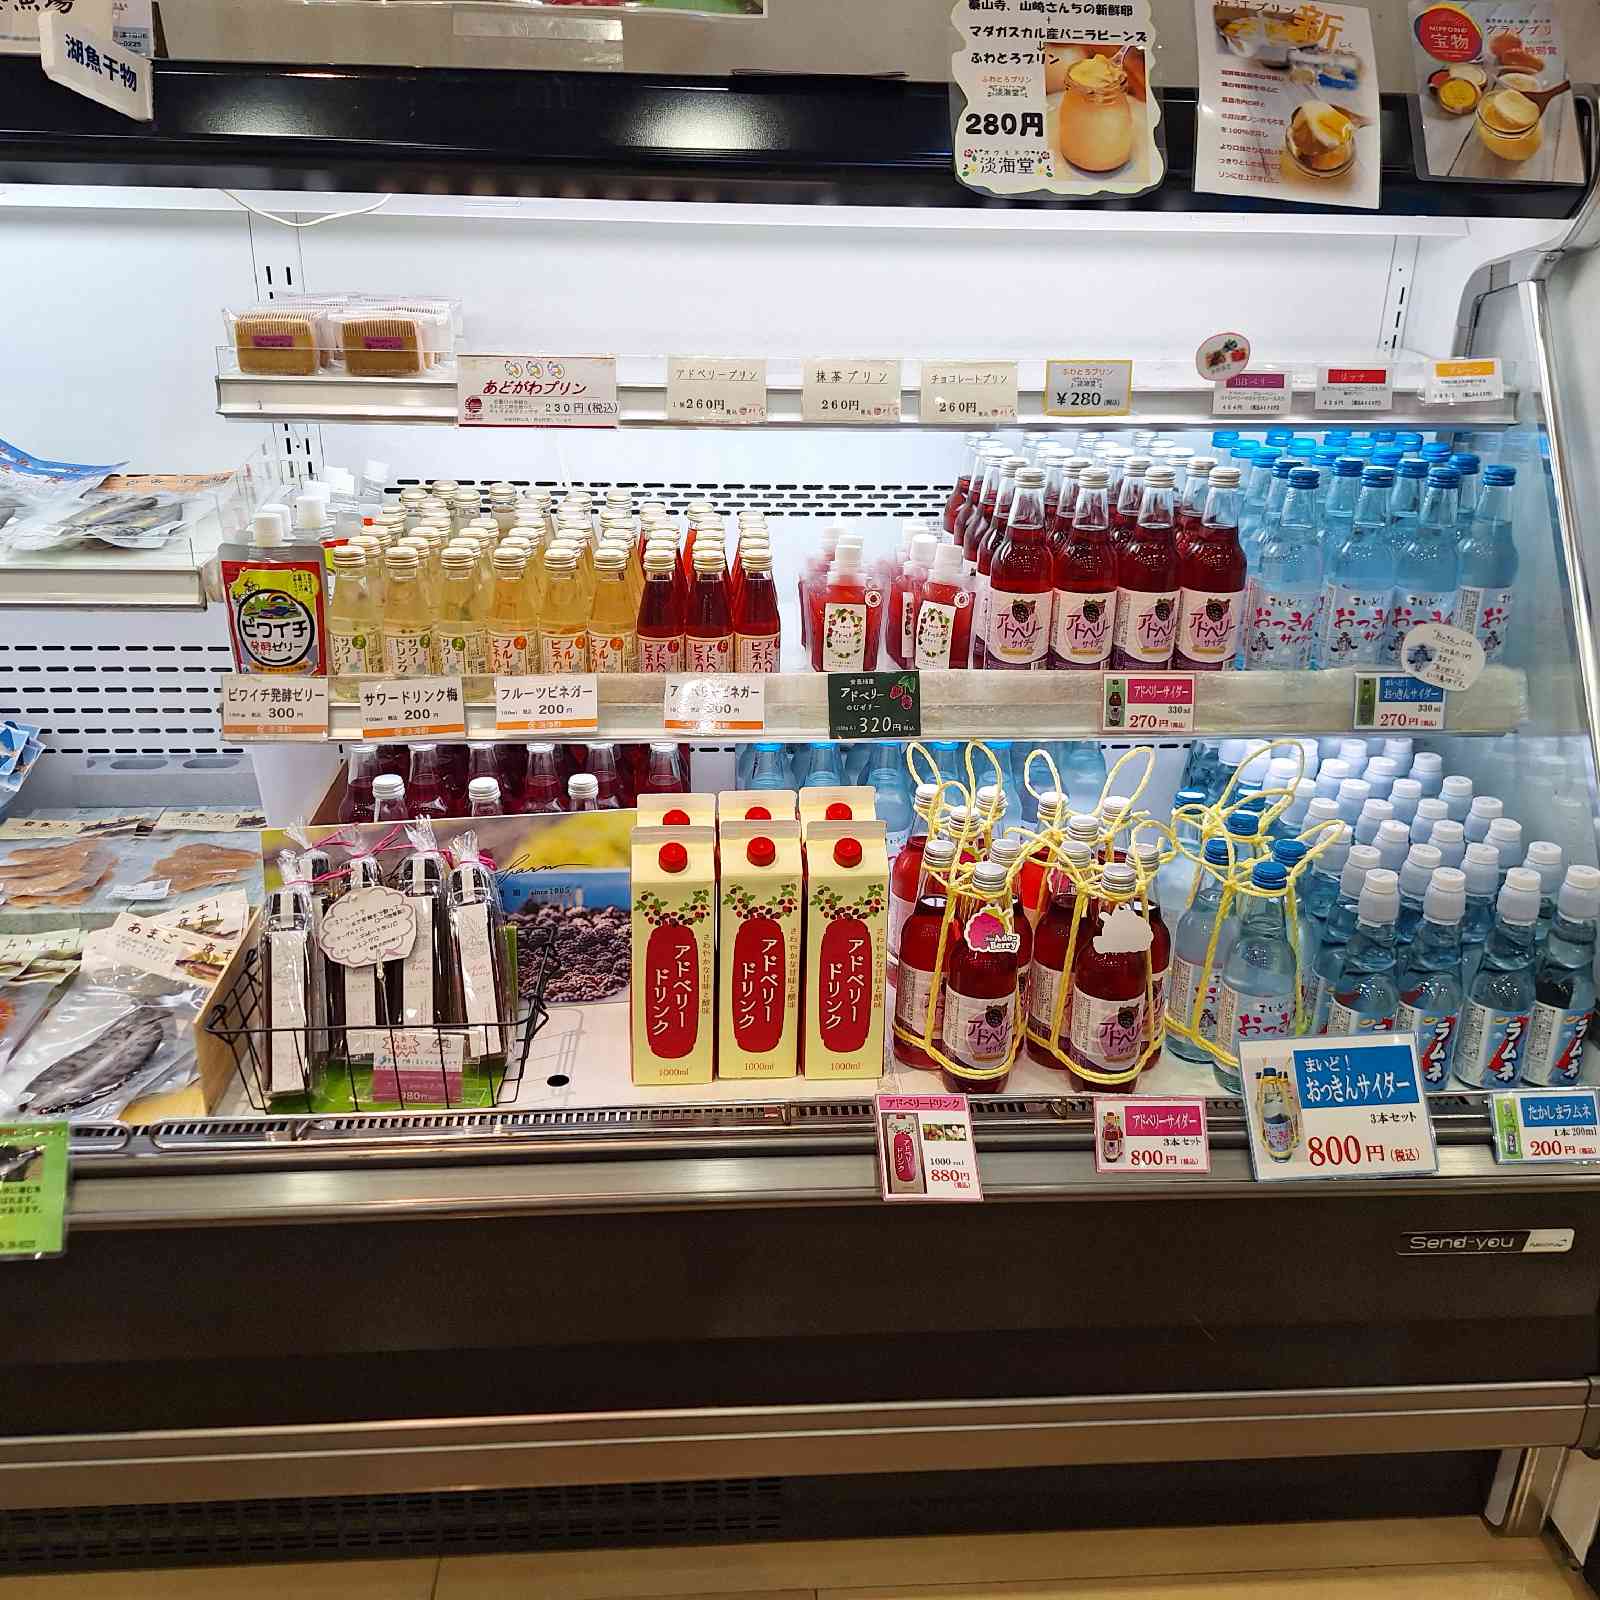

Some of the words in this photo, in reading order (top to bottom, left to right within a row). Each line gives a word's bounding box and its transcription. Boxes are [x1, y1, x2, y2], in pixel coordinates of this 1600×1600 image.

[1429, 33, 1470, 50] 宝物
[65, 33, 137, 92] 湖魚干物
[970, 53, 1060, 65] ふわとろプリン
[965, 112, 1044, 138] 280円
[980, 158, 1035, 175] 淡海堂
[482, 379, 588, 395] あどがわプリン
[931, 374, 1008, 384] チョコレートプリン
[241, 616, 308, 638] ビワイチ
[227, 687, 325, 702] ビワイチ発酵ゼリー
[363, 687, 458, 707] サワードリンク梅
[500, 685, 593, 700] フルーツビネガー
[840, 687, 886, 700] アドベリー
[672, 945, 693, 1028] アドベリー
[758, 939, 778, 1022] アドベリー
[847, 939, 865, 1022] アドベリー
[651, 968, 671, 1036] ドリンク
[738, 962, 757, 1030] ドリンク
[824, 963, 843, 1030] ドリンク
[1424, 1020, 1451, 1083] ラムネ
[1495, 1021, 1522, 1082] ラムネ
[1562, 1018, 1589, 1079] ラムネ
[1303, 1055, 1351, 1073] まいど！
[1305, 1072, 1410, 1102] おっきんサイダー
[885, 1097, 961, 1109] アドベリードリンク
[1527, 1103, 1592, 1120] たかしまラムネ
[1131, 1113, 1198, 1129] アドベリーサイダー
[1370, 1111, 1417, 1124] 3本セット
[1409, 1235, 1515, 1250] Send-you
